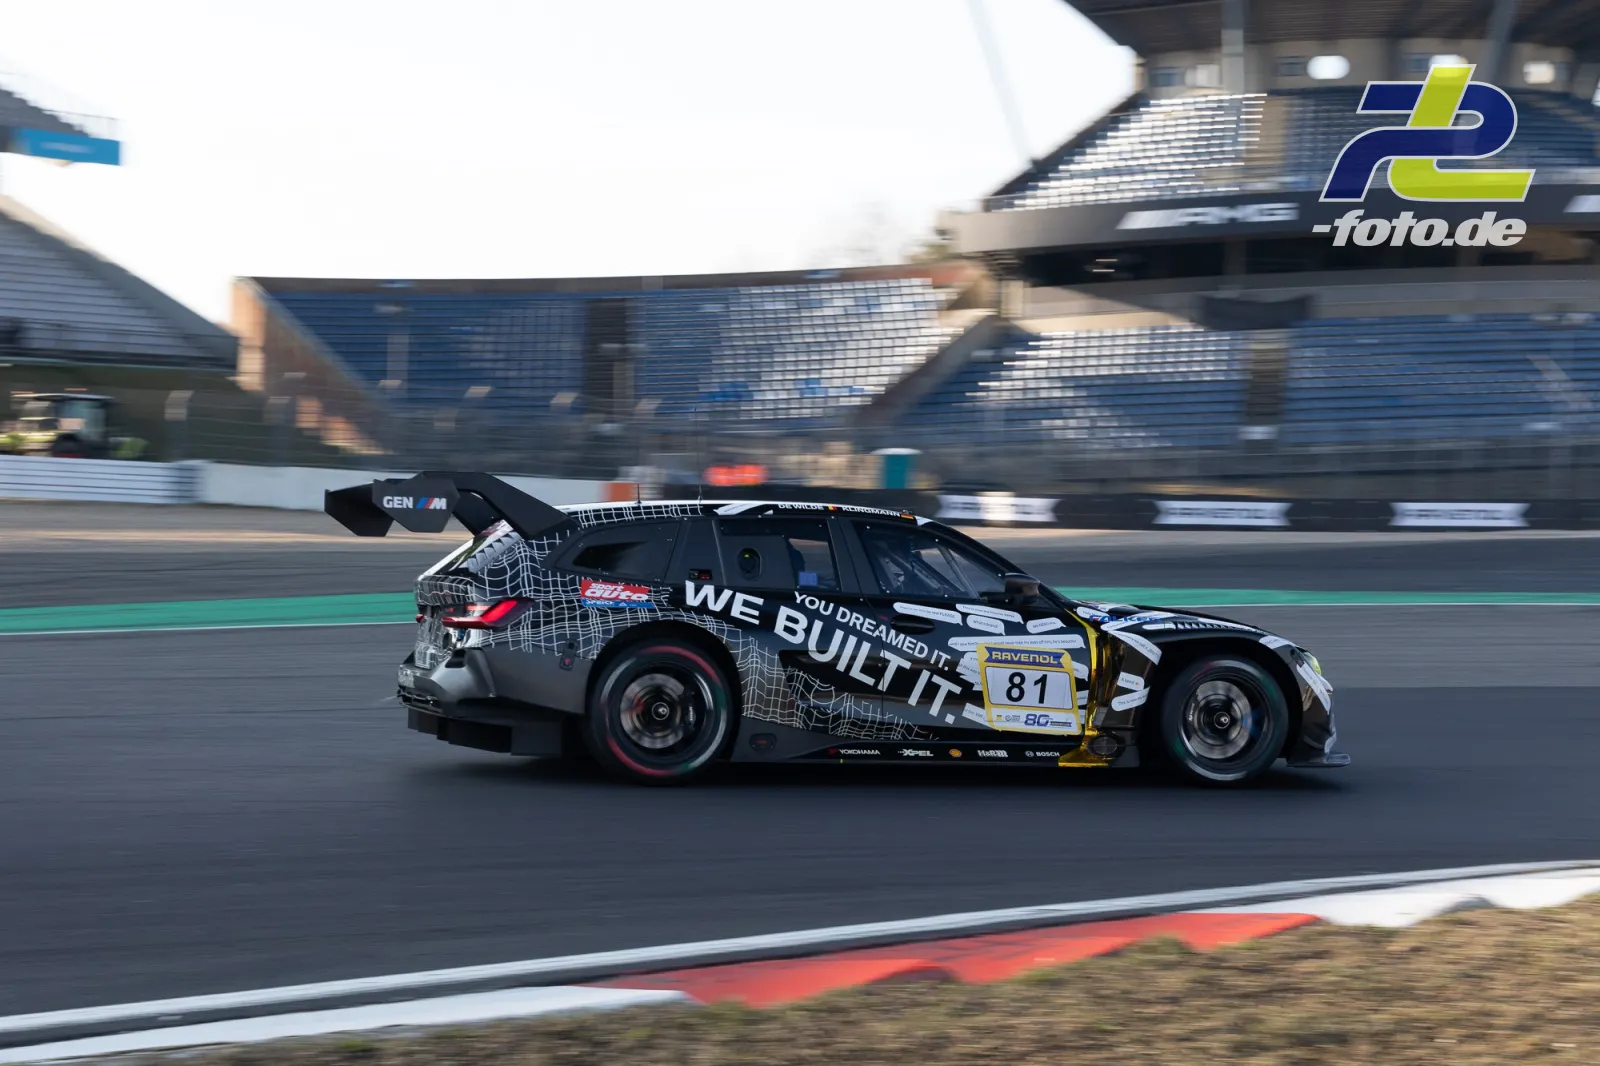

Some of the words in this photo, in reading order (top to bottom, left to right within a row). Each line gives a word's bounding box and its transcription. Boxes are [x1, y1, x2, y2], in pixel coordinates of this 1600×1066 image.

[382, 496, 413, 509] GEN
[589, 583, 624, 591] sport
[584, 589, 649, 601] auto
[794, 590, 835, 616] YOU
[836, 606, 929, 659] DREAMED
[929, 648, 952, 671] IT.
[685, 580, 765, 625] WE
[773, 605, 911, 692] BUILT
[907, 669, 963, 725] IT.
[991, 651, 1058, 664] RAVENOL
[1005, 671, 1048, 705] 81
[1024, 713, 1050, 728] 80
